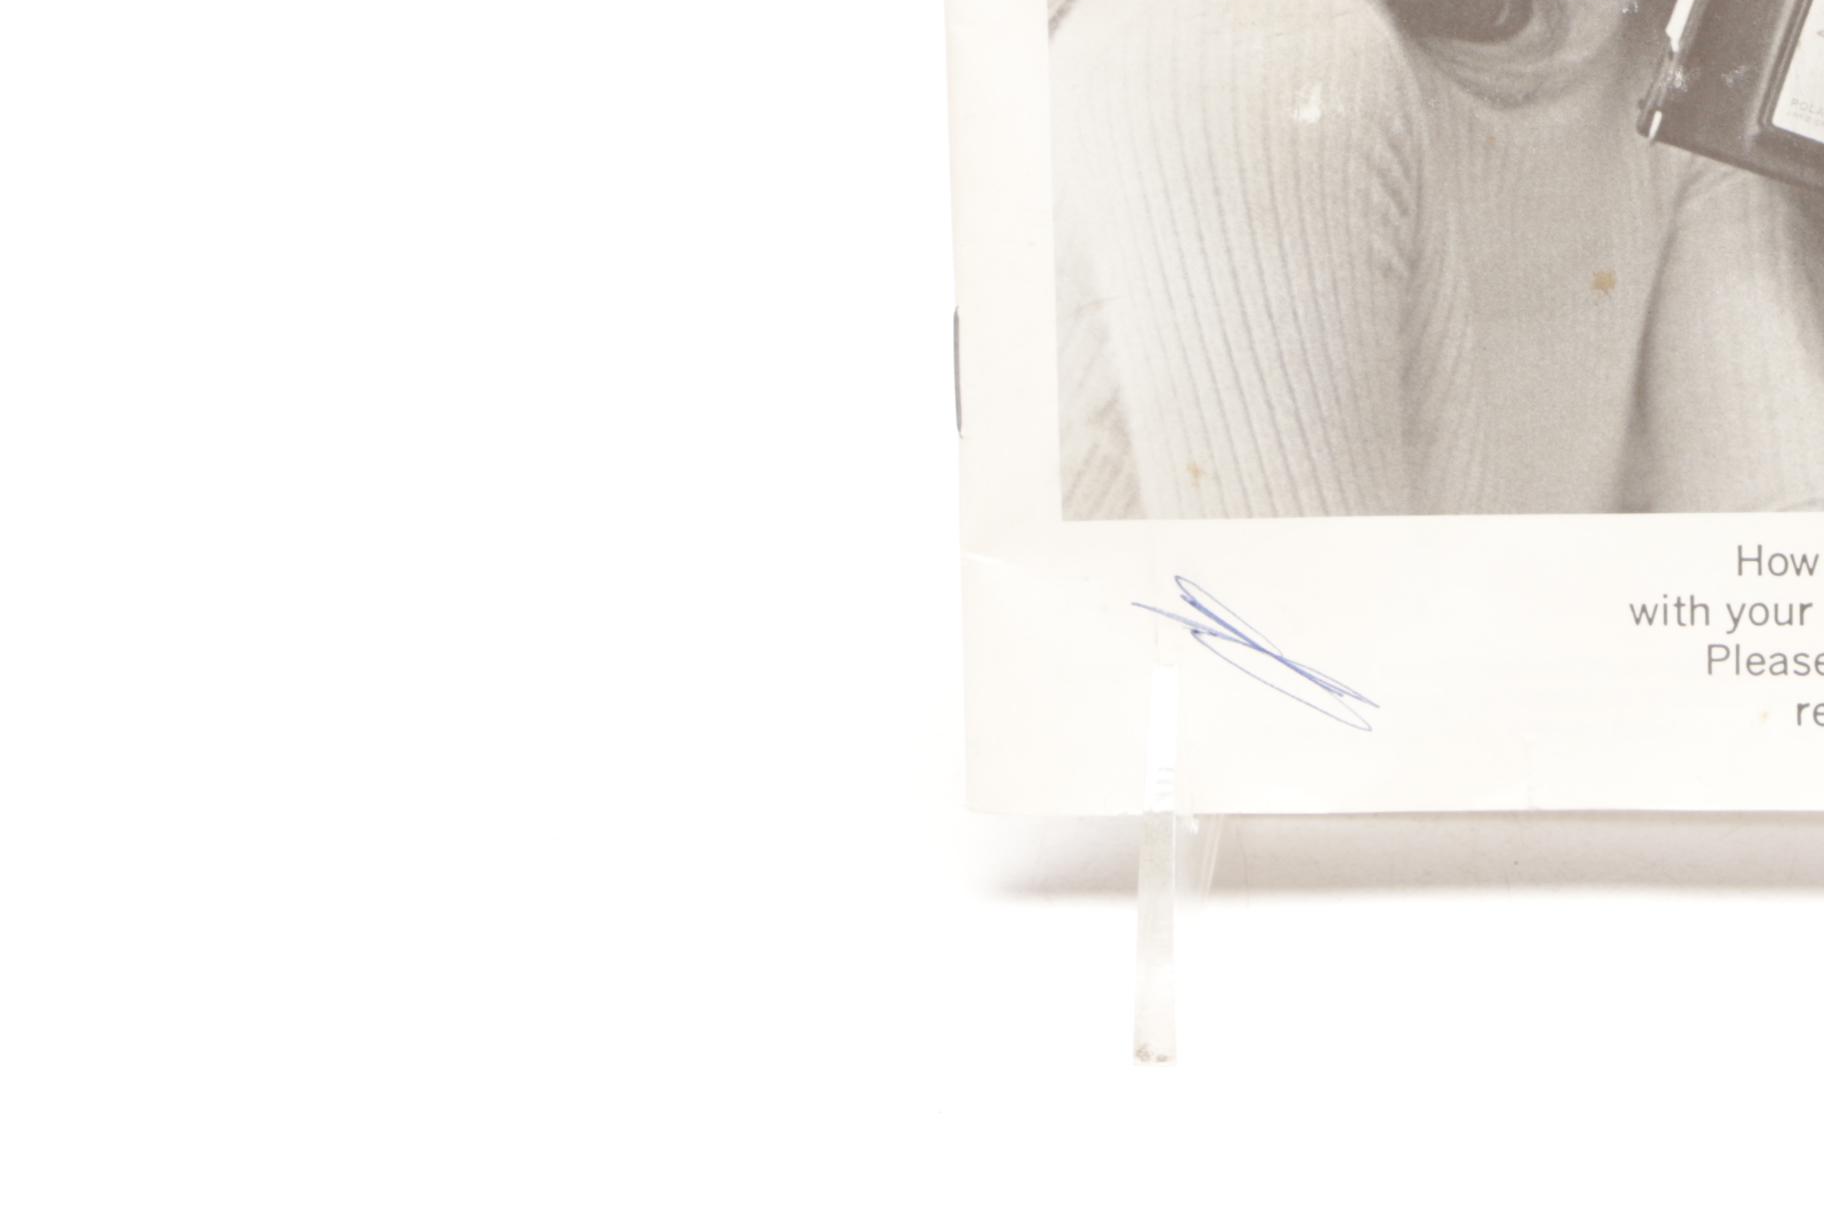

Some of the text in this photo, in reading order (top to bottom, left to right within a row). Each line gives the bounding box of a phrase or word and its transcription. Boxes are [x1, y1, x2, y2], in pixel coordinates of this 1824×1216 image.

[1737, 544, 1820, 577] How
[1629, 593, 1710, 627] with
[1726, 602, 1813, 635] your
